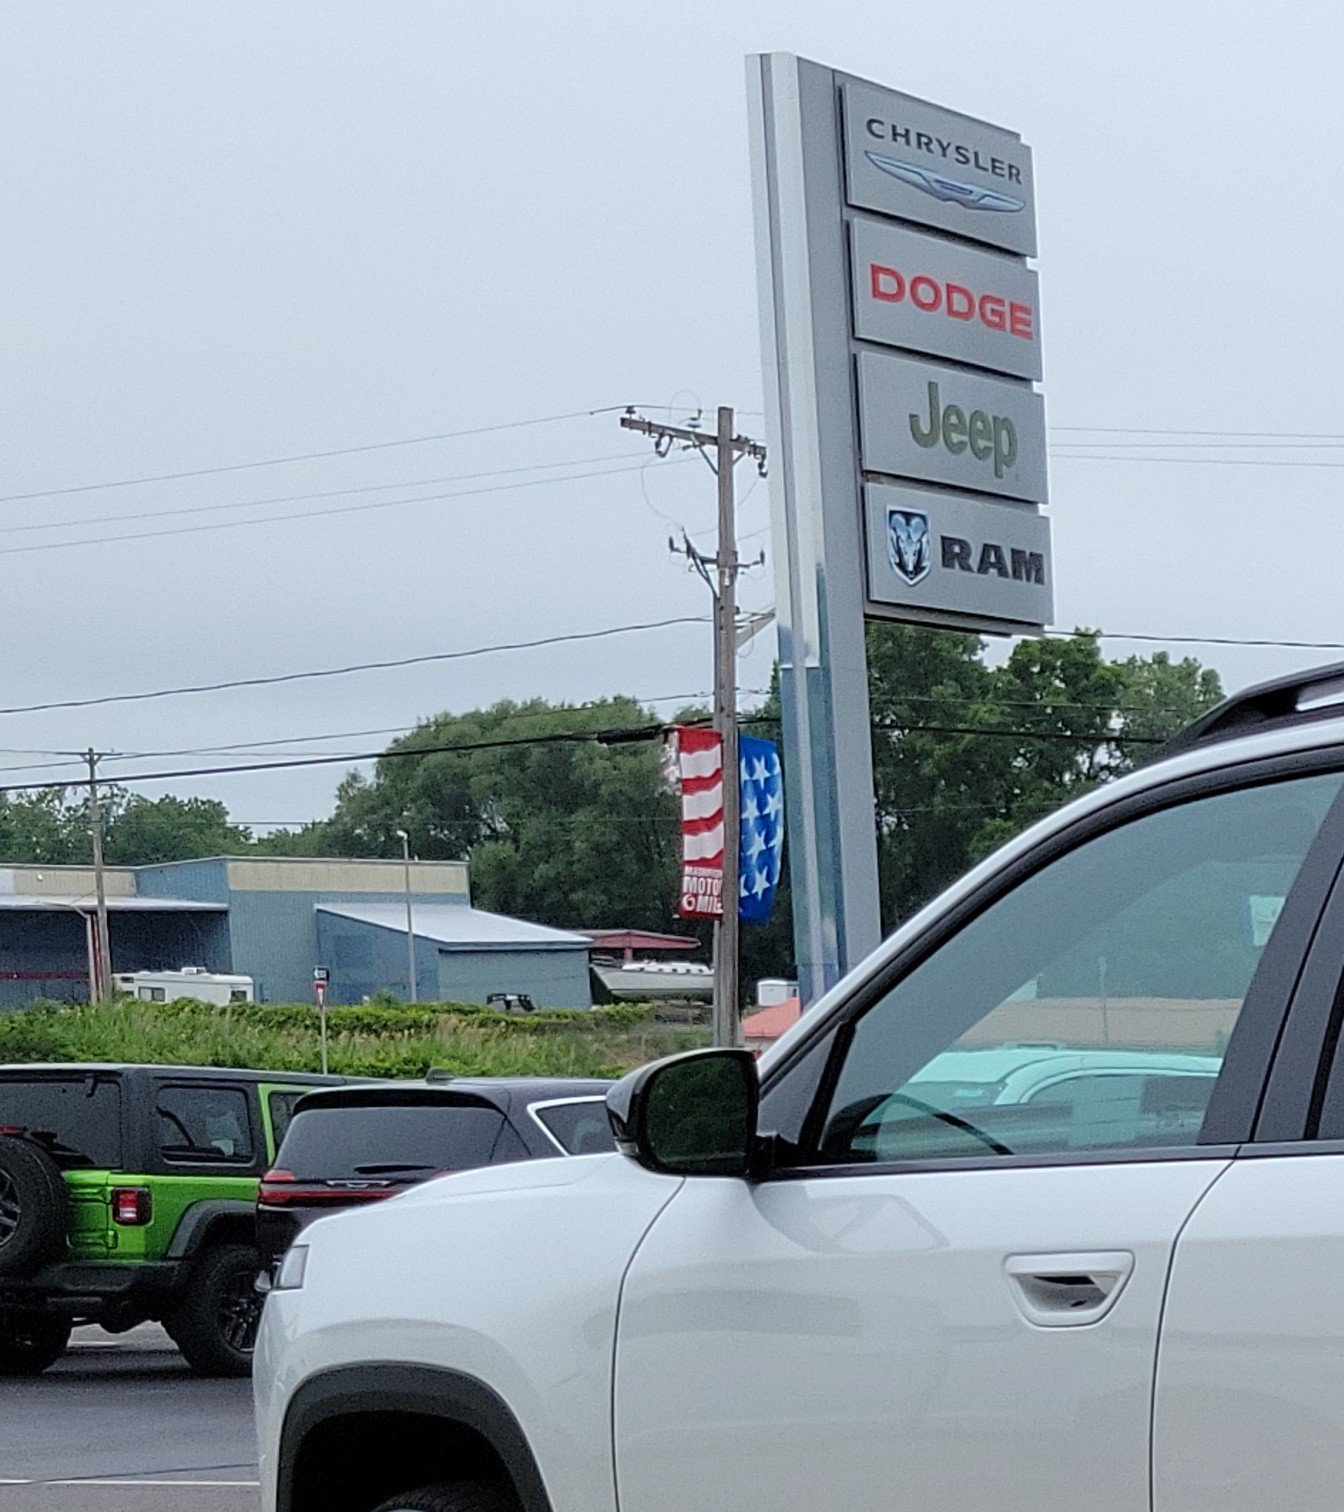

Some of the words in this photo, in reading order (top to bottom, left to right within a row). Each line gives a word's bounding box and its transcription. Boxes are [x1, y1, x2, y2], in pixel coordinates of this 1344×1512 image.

[865, 117, 1023, 186] CHRYSLER
[870, 263, 1033, 340] DODGE
[909, 381, 1018, 479] Jeep
[940, 535, 1046, 585] RAM
